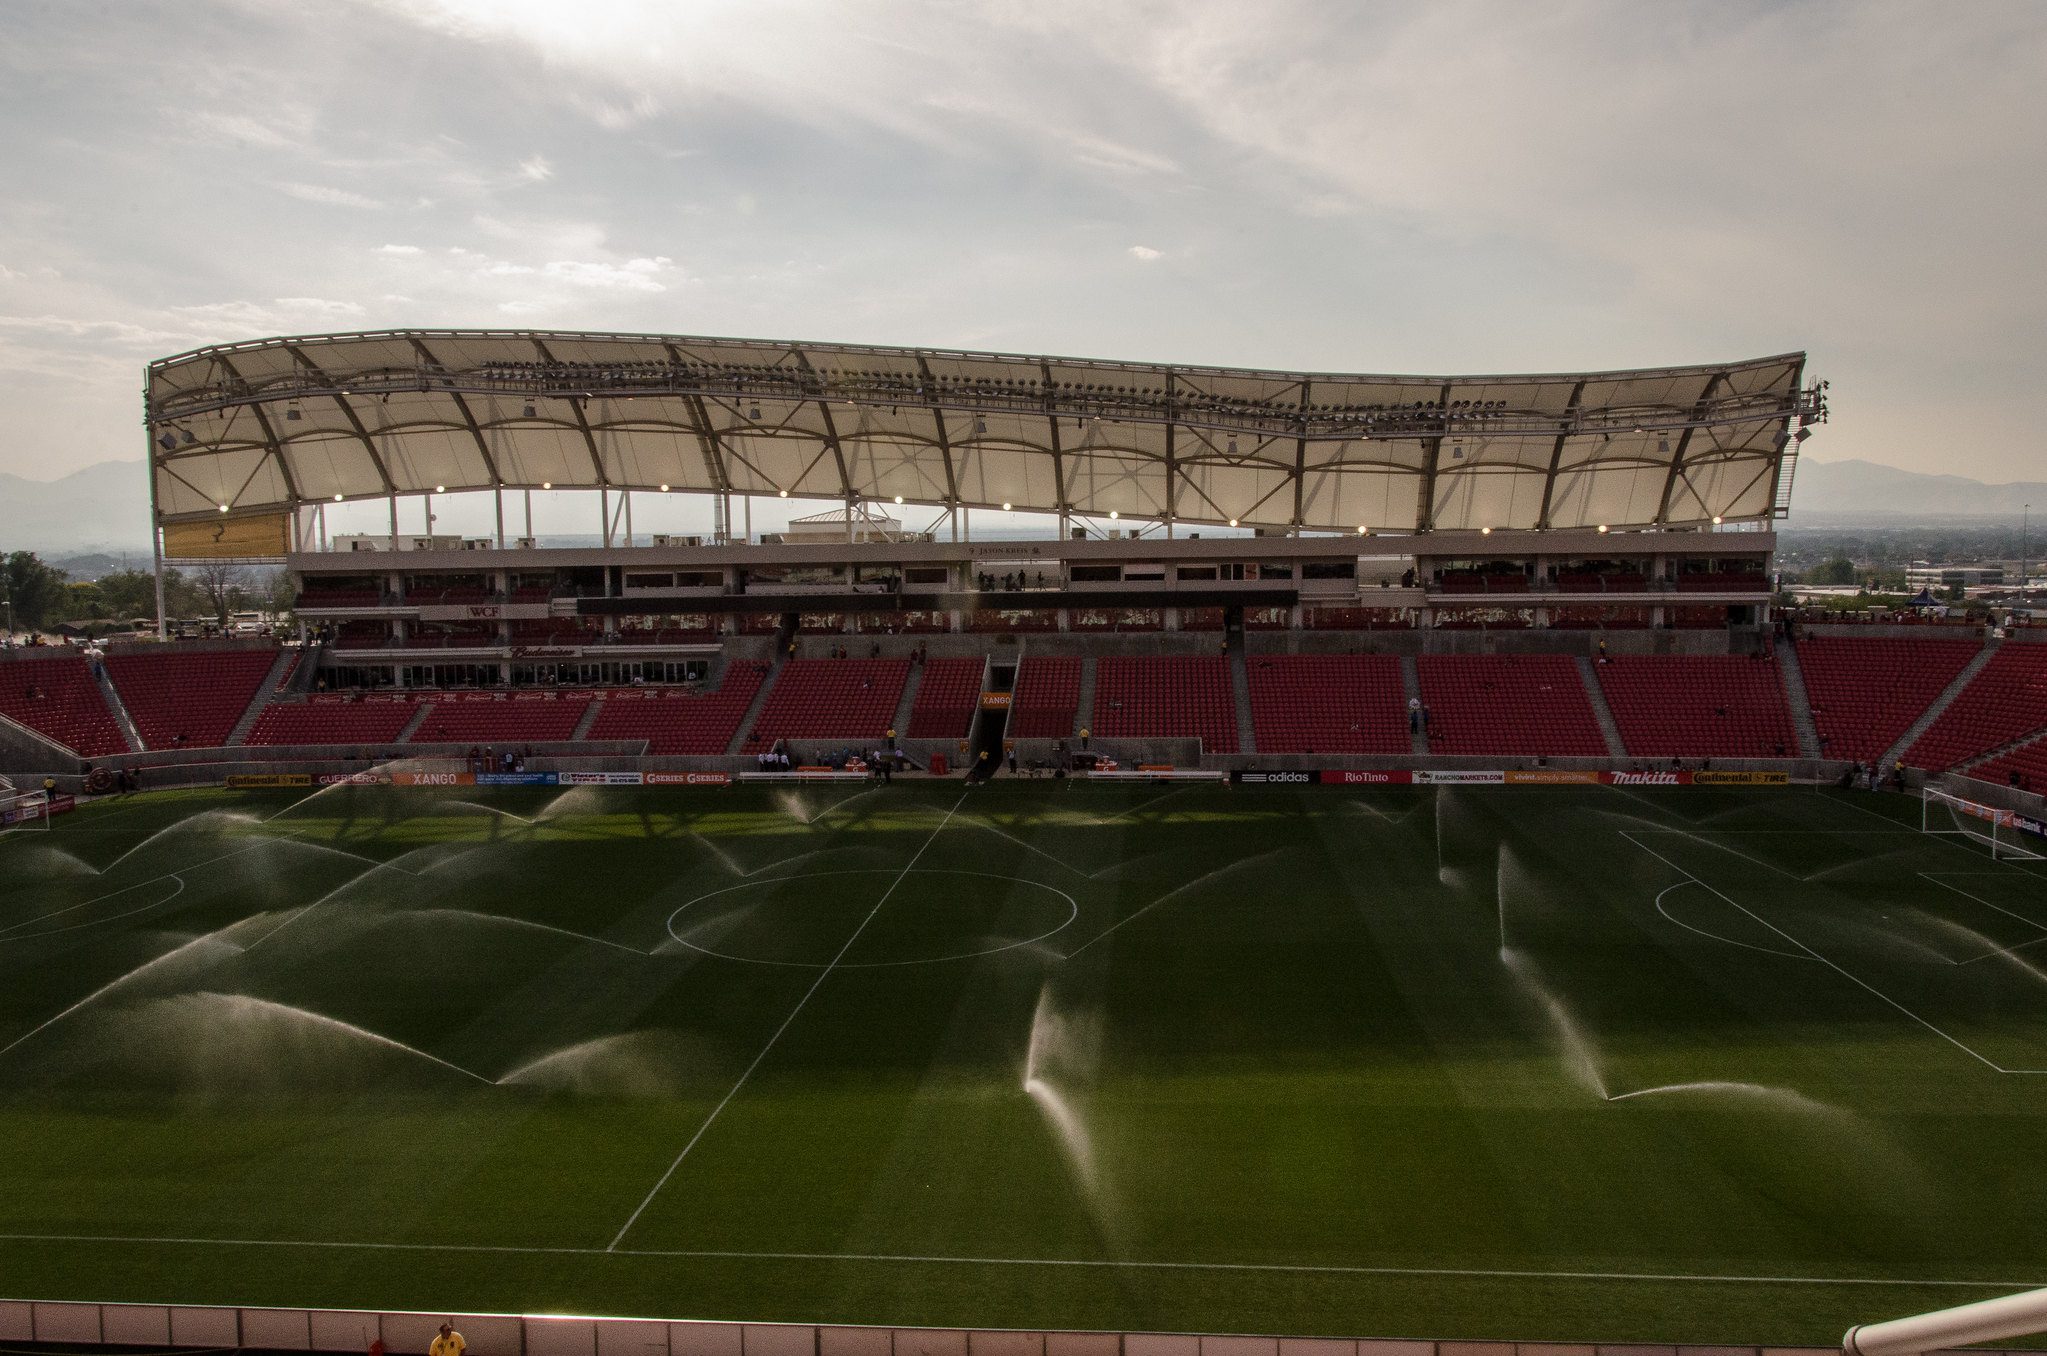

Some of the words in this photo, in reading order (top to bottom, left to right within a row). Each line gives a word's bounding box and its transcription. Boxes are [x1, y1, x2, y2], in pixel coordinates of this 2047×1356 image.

[470, 607, 499, 617] WCF
[983, 696, 1010, 704] XANGO
[319, 774, 377, 784] GUERRERO
[413, 773, 457, 784] XANGO
[1268, 772, 1309, 782] adidas
[1694, 773, 1752, 783] Continental
